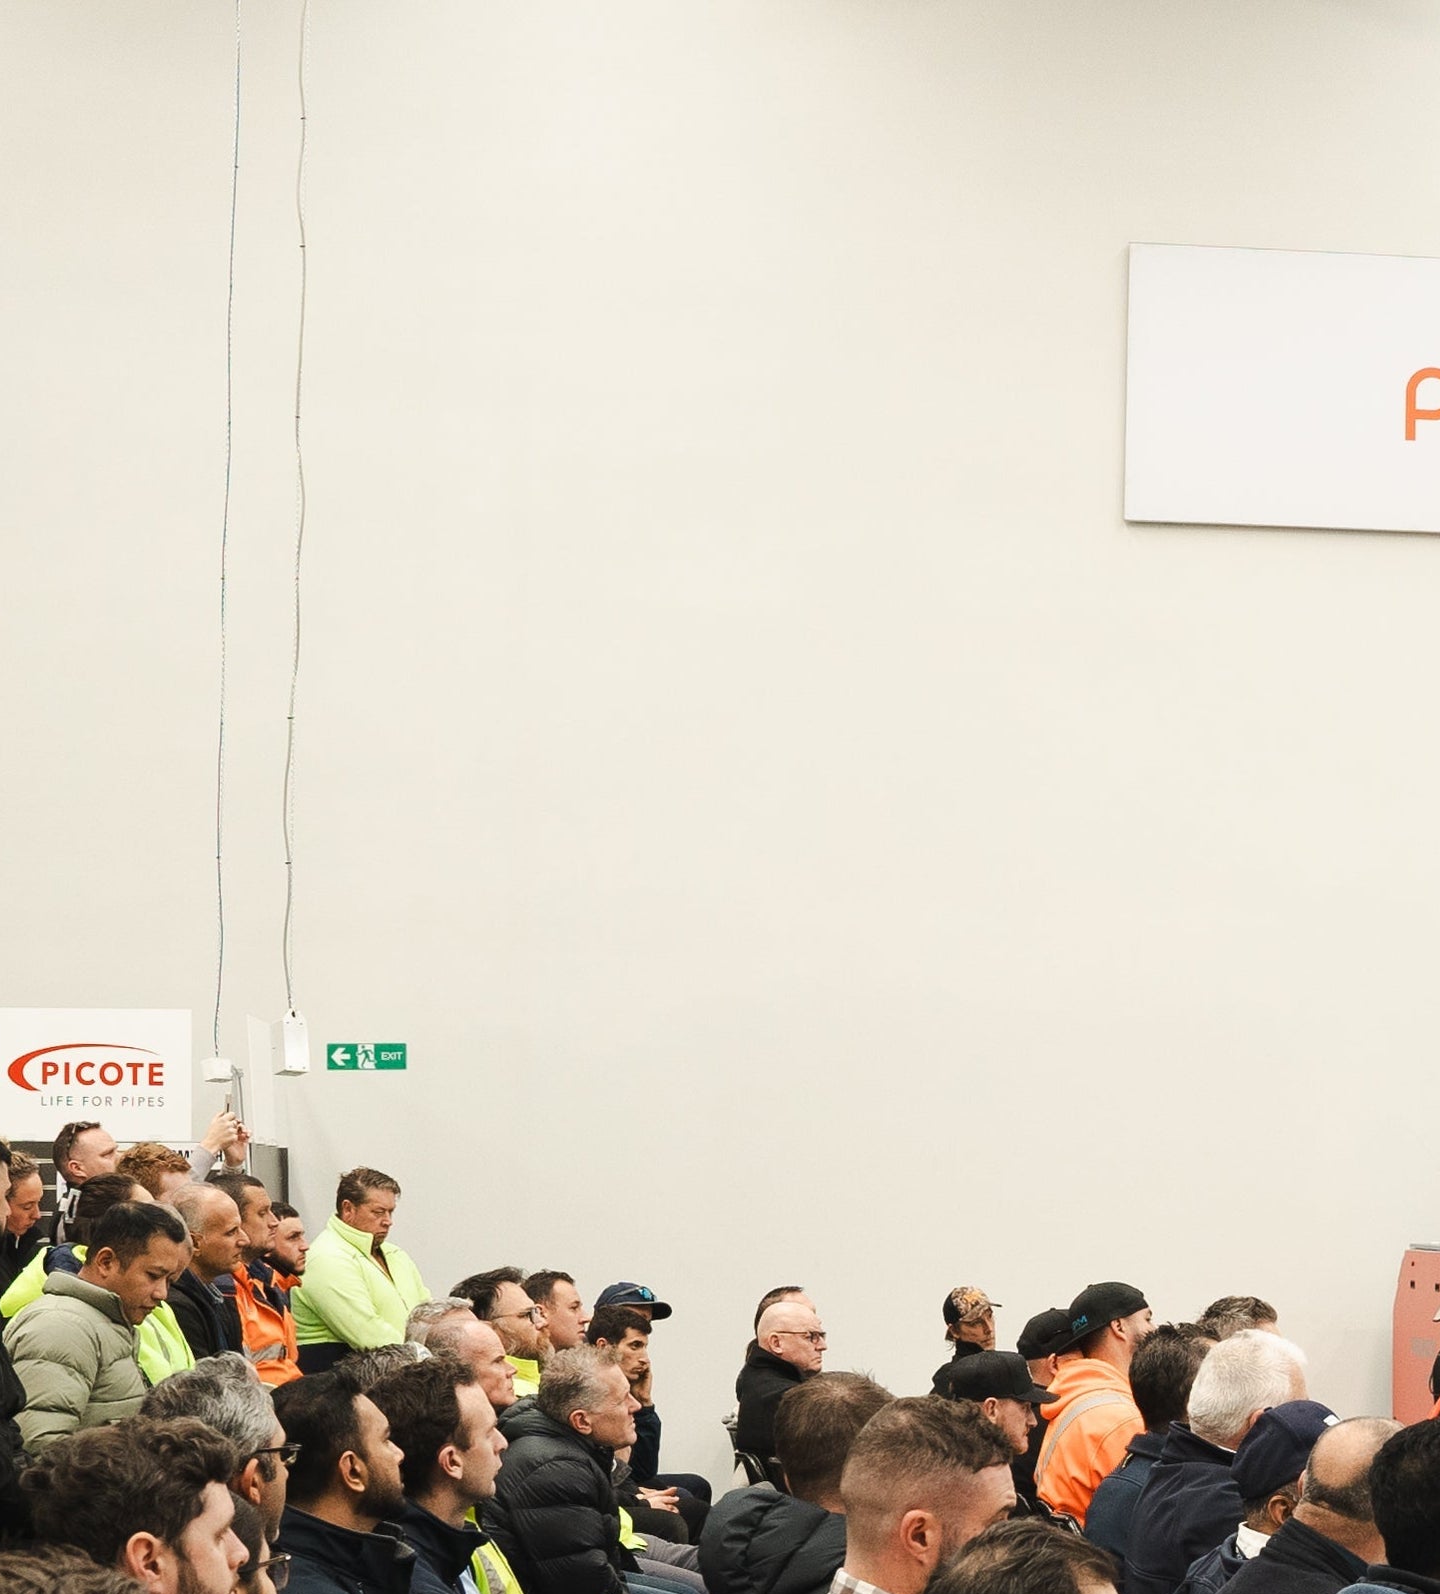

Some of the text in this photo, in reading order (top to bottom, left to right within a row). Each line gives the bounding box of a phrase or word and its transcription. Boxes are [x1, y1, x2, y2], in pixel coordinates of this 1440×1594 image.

[381, 1051, 403, 1061] EXIT
[41, 1062, 164, 1086] PICOTE
[41, 1096, 165, 1108] LIFE FOR PIPES
